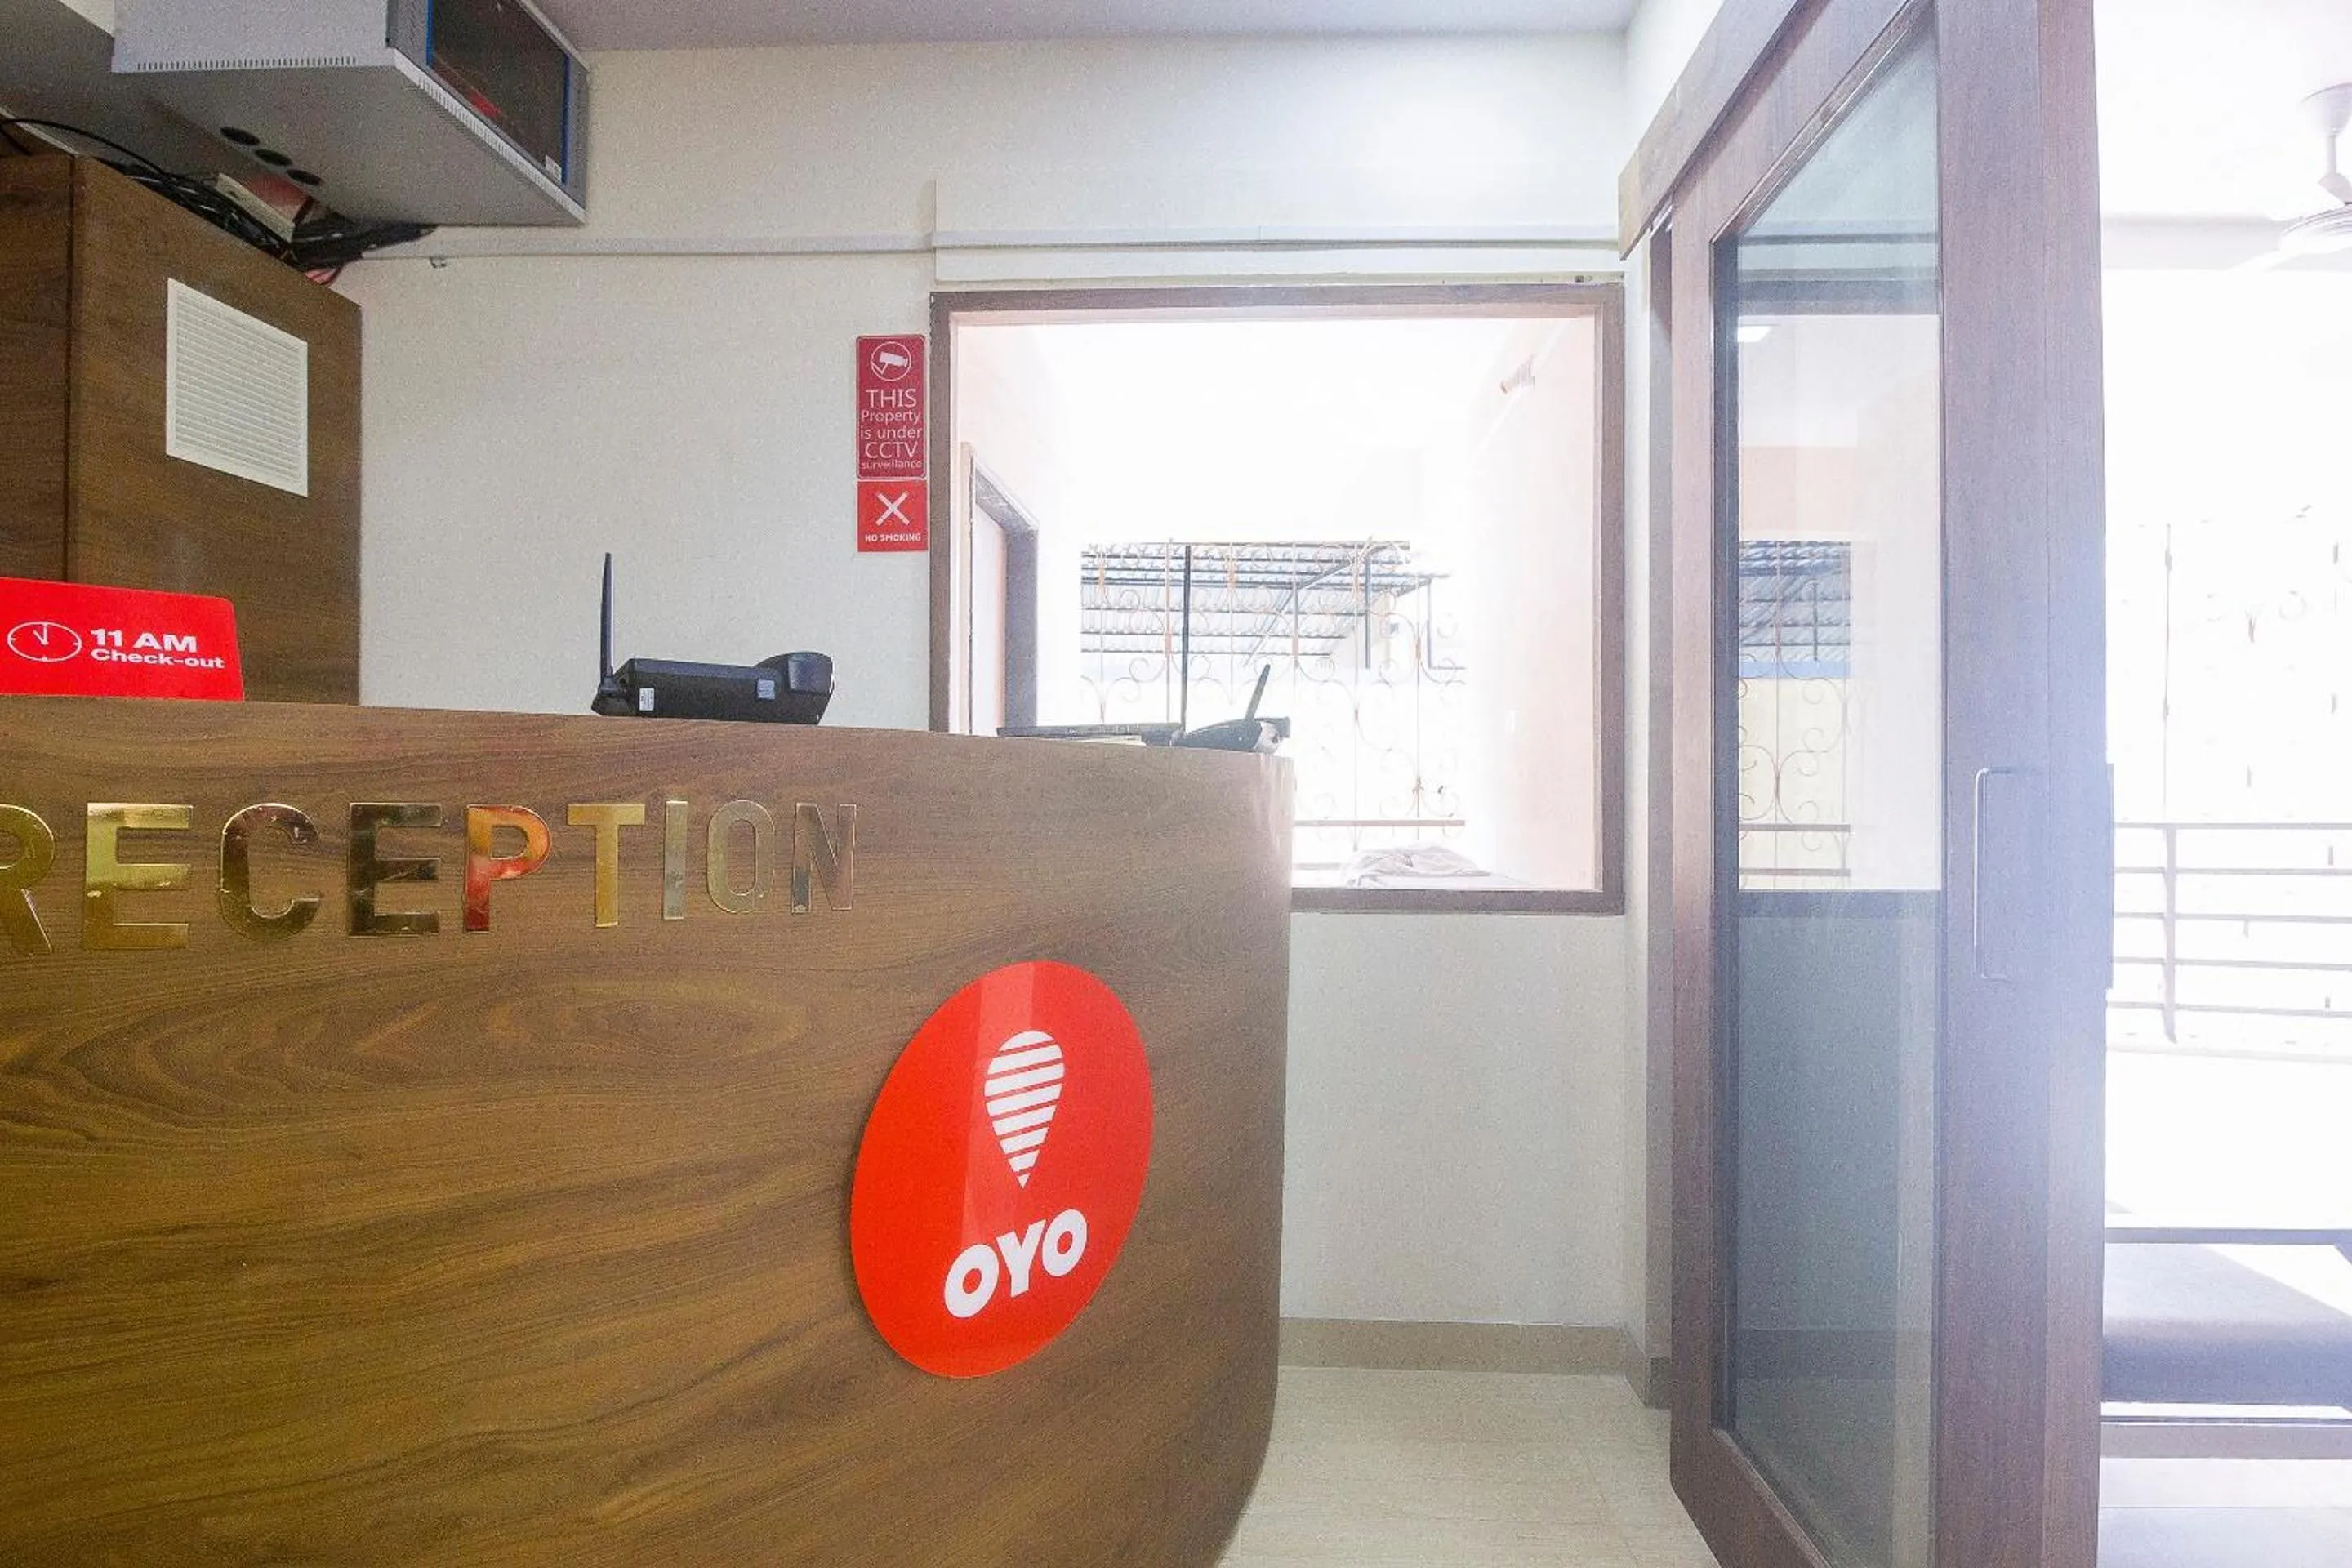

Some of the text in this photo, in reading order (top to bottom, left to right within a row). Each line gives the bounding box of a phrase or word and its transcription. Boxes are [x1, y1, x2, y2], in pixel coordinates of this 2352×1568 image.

[866, 389, 917, 408] THIS
[861, 410, 921, 424] Property
[861, 425, 923, 439] is under
[865, 441, 918, 458] CCTV
[865, 532, 921, 542] NO SMOKING
[91, 629, 197, 653] 11 AM
[91, 648, 225, 668] Check-out
[944, 1209, 1087, 1317] OYO
